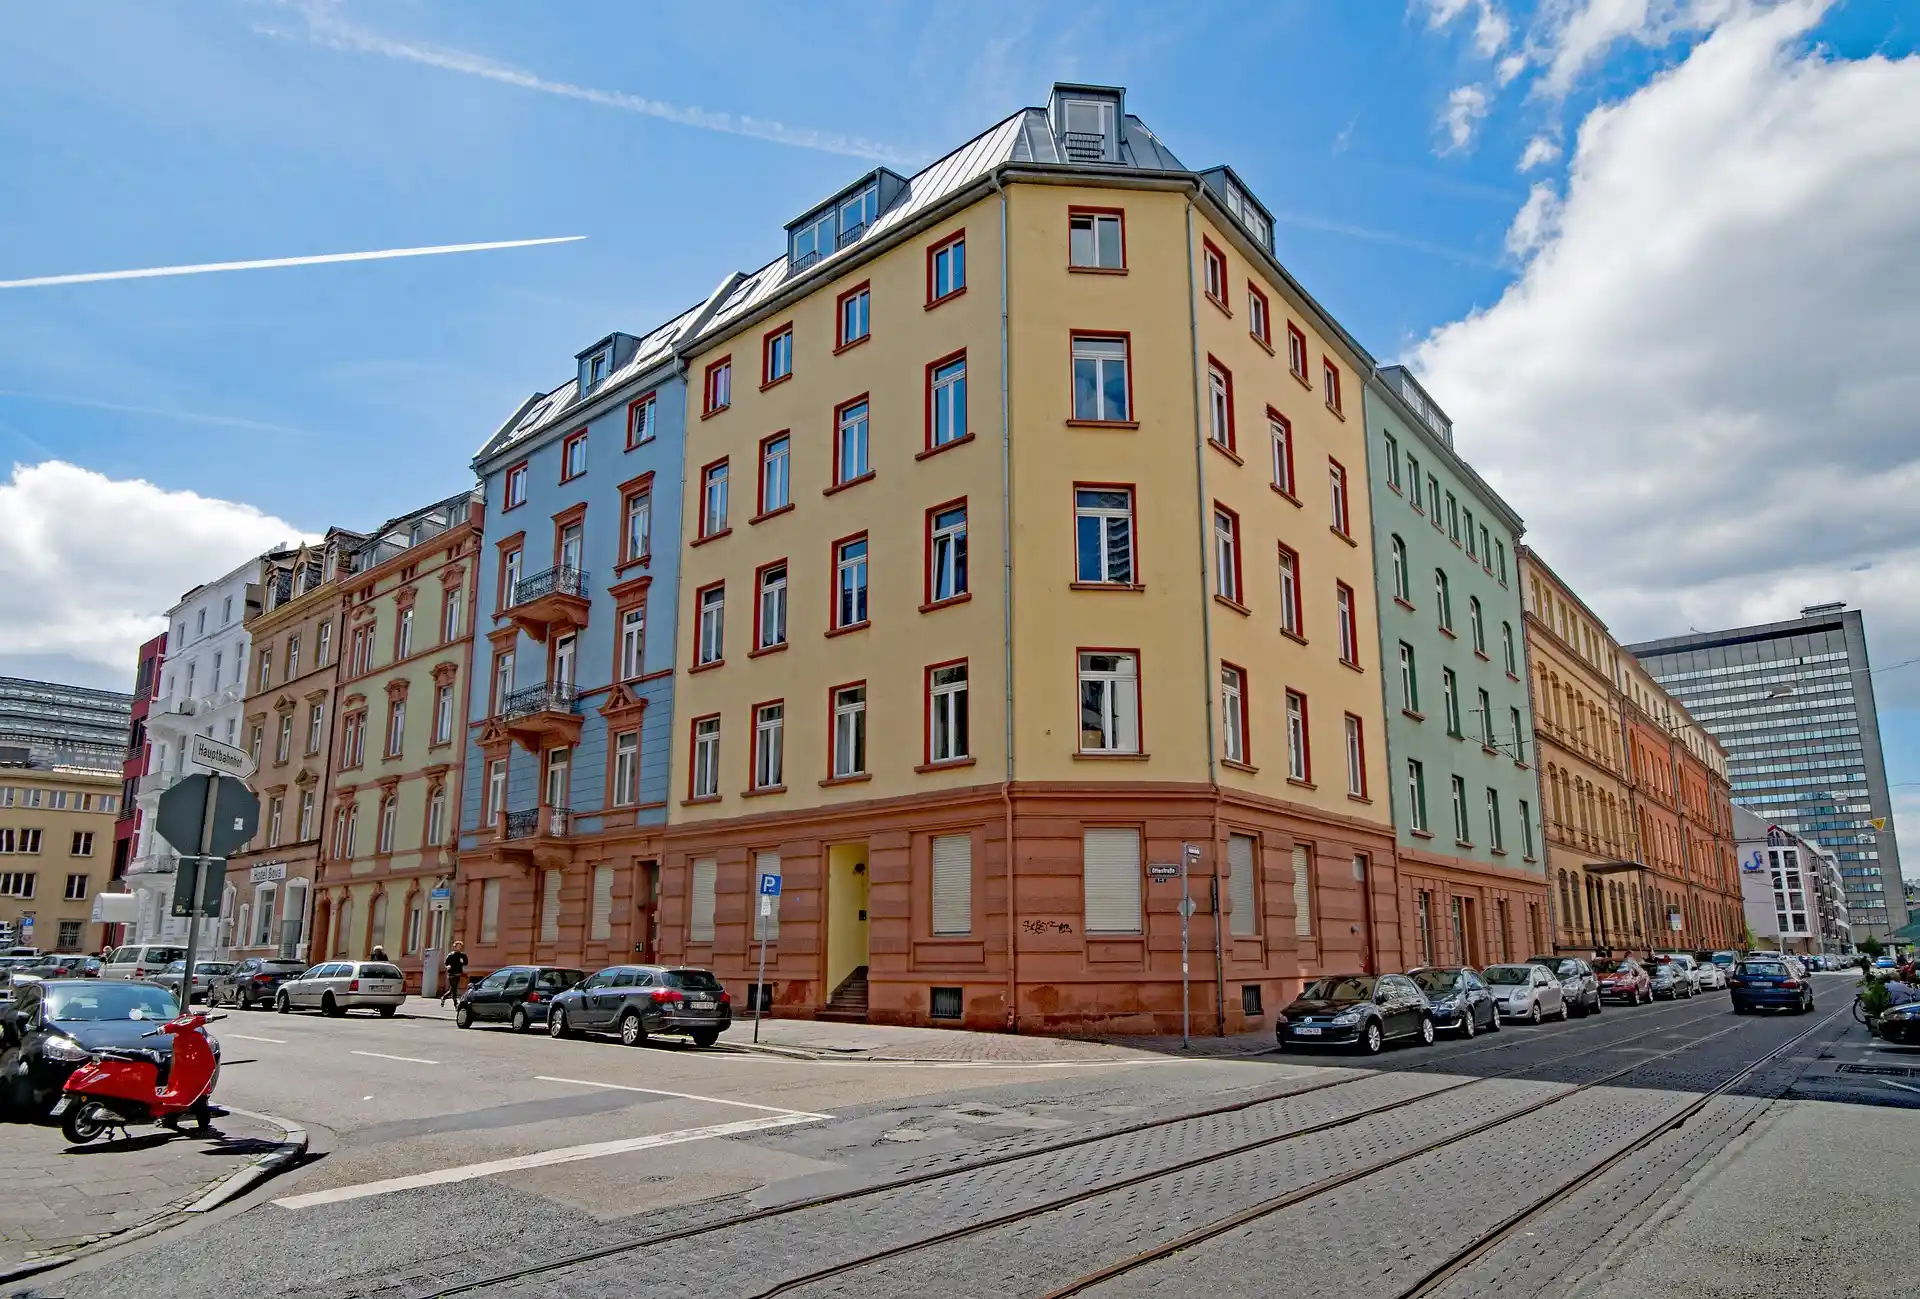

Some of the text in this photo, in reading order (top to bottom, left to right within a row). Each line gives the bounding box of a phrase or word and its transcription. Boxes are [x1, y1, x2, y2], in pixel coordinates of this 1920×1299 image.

[198, 743, 243, 768] Hauptbahnhof
[254, 868, 268, 881] Hotel
[763, 876, 775, 892] P
